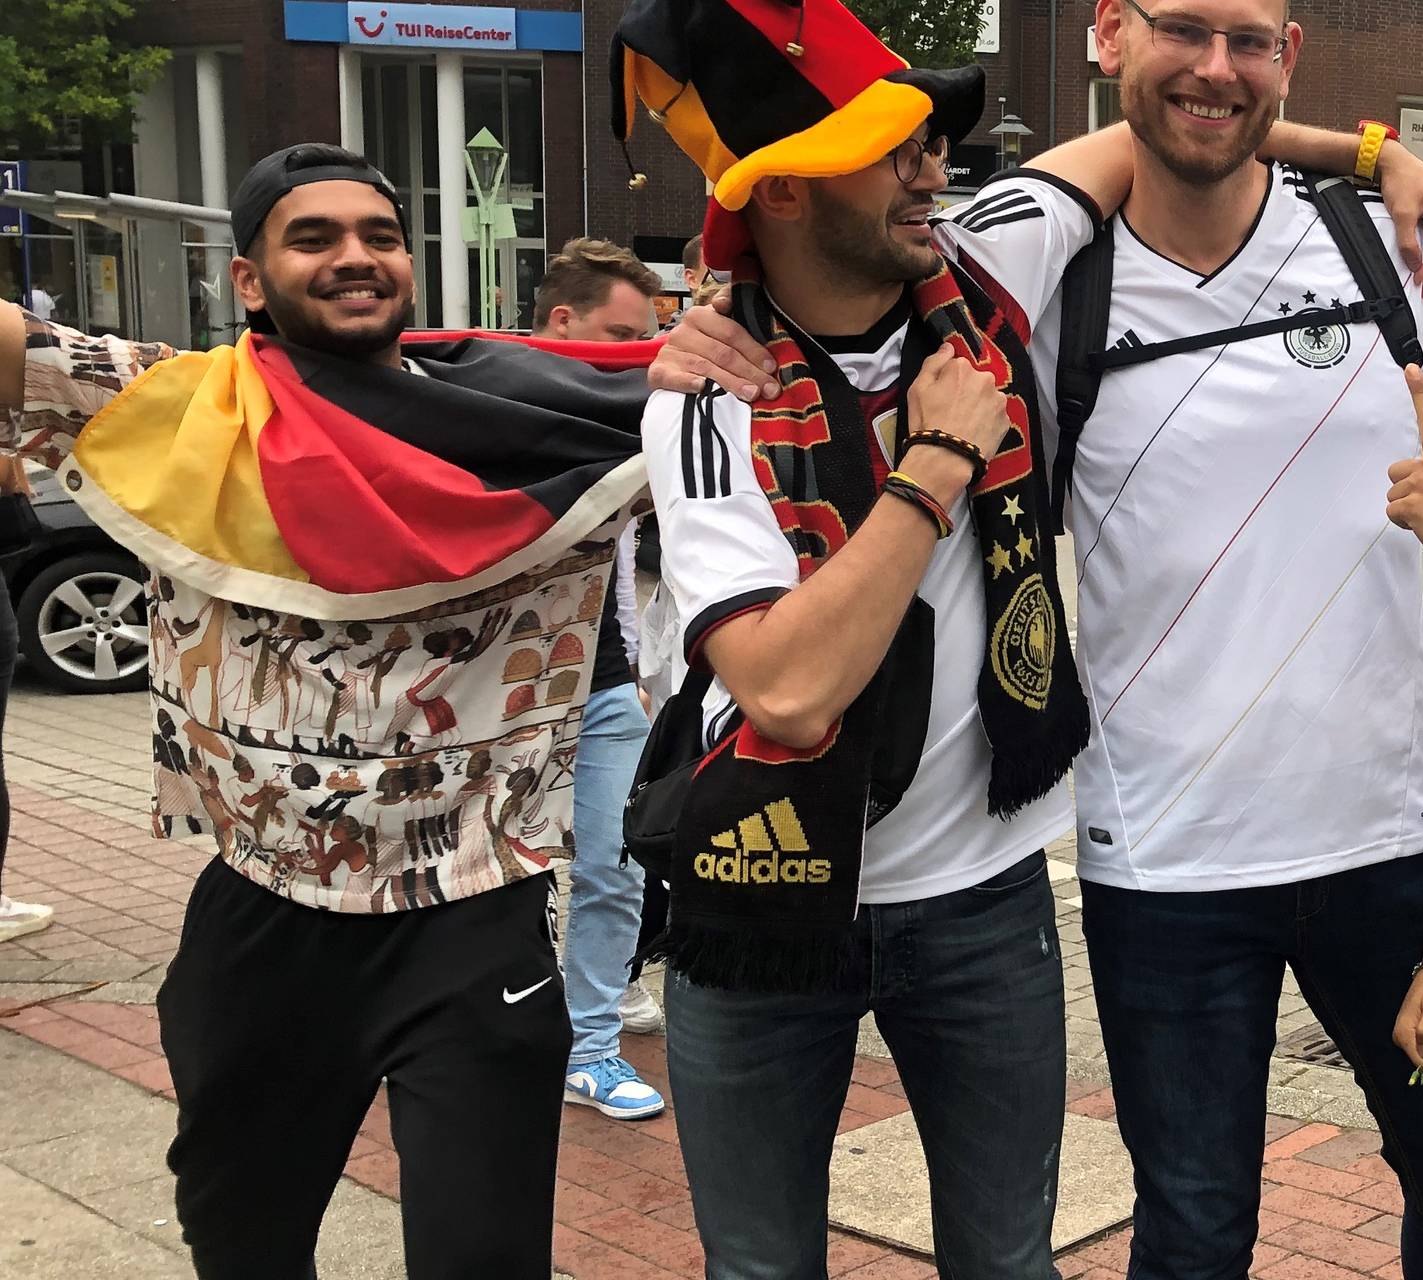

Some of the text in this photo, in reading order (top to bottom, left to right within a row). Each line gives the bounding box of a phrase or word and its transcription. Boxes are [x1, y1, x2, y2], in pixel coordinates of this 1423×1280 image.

[395, 23, 512, 41] TUI ReiseCenter
[1411, 123, 1423, 133] RH
[693, 848, 832, 884] adidas
